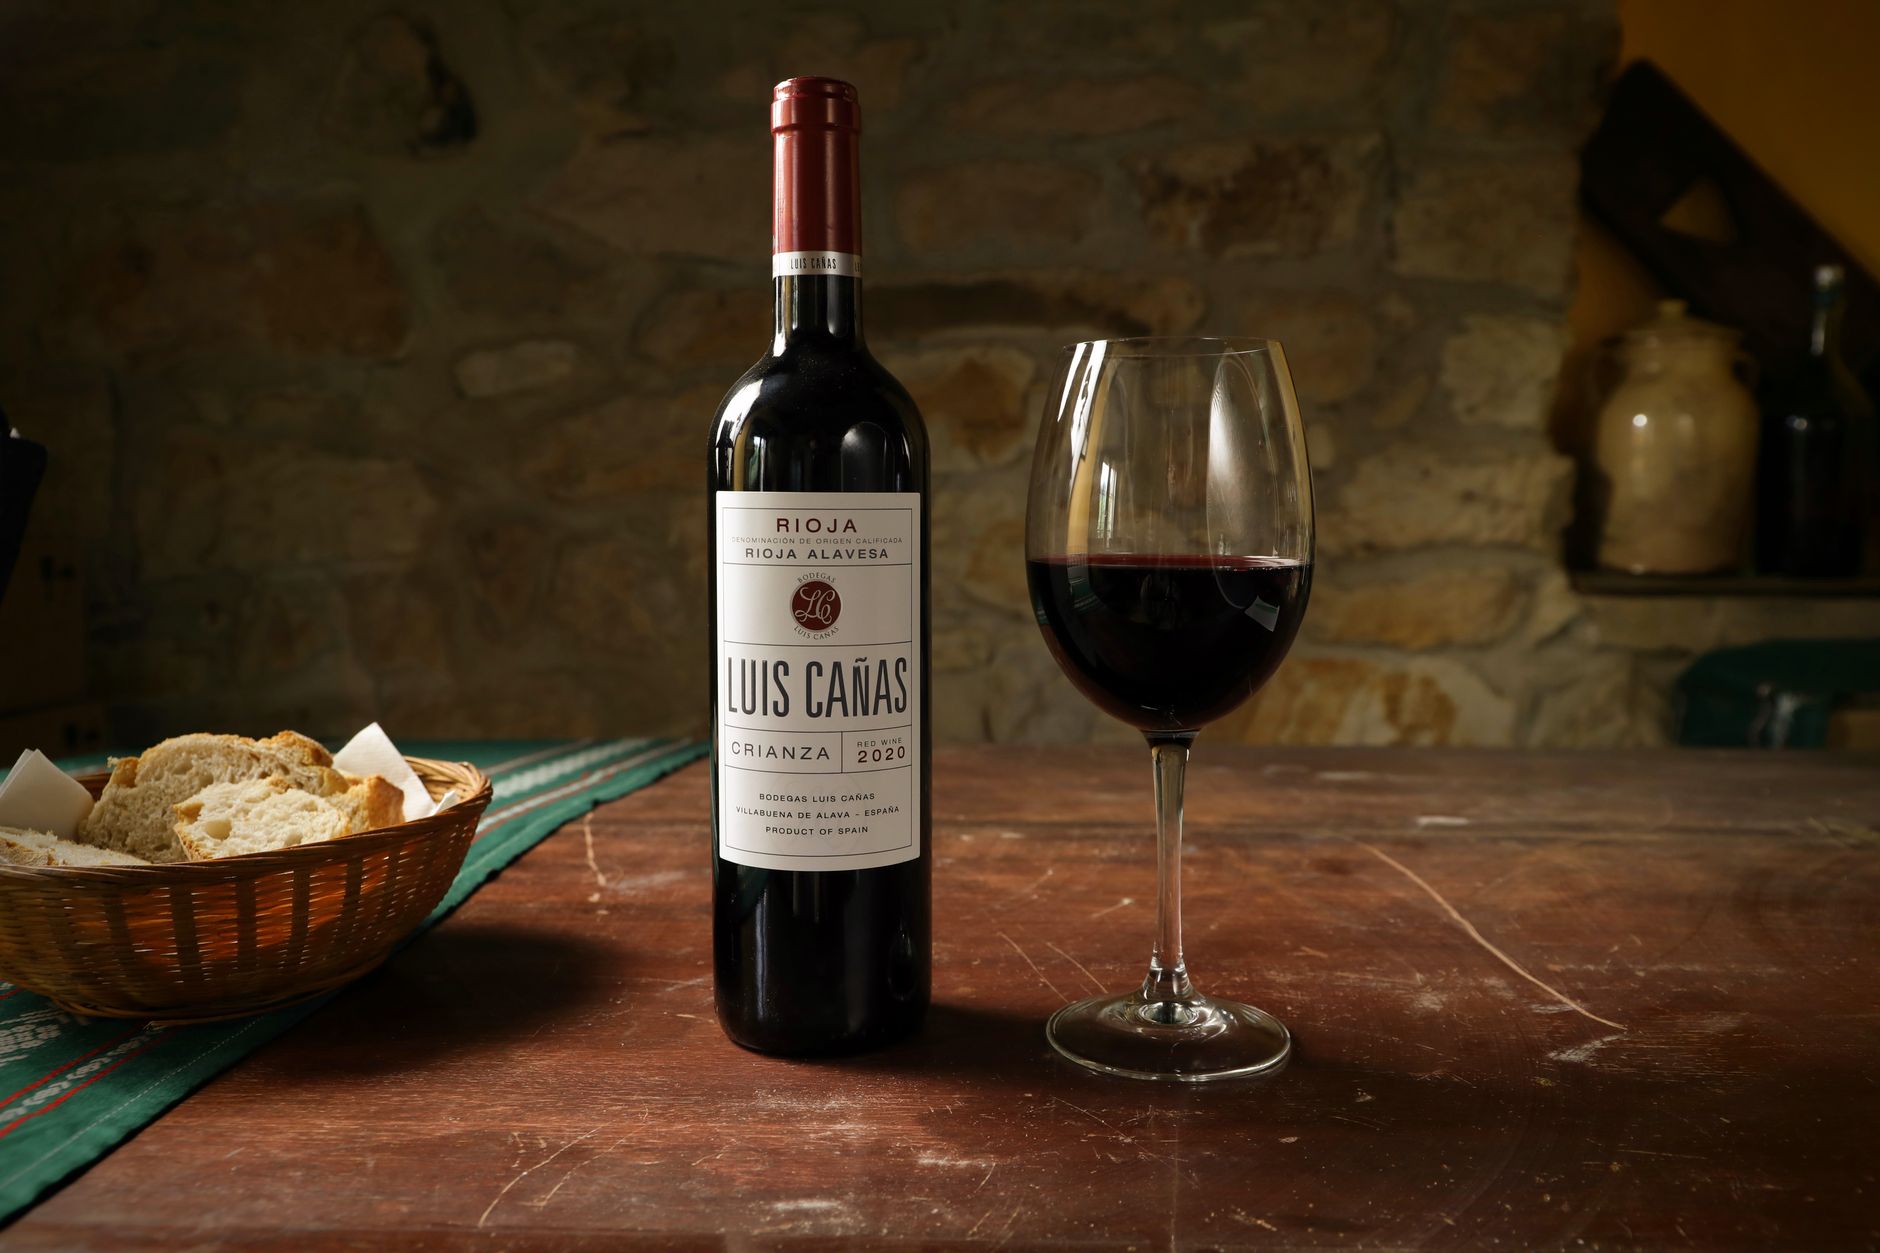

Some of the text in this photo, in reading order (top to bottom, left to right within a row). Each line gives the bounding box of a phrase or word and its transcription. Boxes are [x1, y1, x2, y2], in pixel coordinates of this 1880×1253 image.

[790, 256, 837, 270] LUIS CAÑAS
[776, 518, 857, 533] RIOJA
[731, 536, 795, 544] DENOMINACIÓN
[799, 537, 810, 545] DE
[815, 537, 852, 545] ORIGEN
[745, 548, 889, 560] RIOJA ALAVESA
[797, 571, 837, 584] BODEGAS
[793, 625, 811, 640] LUIS
[727, 656, 907, 718] LUIS CAÑAS
[856, 737, 903, 748] RED WINE
[731, 741, 830, 760] CRIANZA
[857, 746, 906, 764] 2020
[759, 792, 876, 803] BODEGAS LUIS CAÑAS
[735, 806, 793, 819] VILLABUENA
[864, 805, 900, 817] ESPAÑA
[765, 826, 869, 836] PRODUCT OF SPAIN
